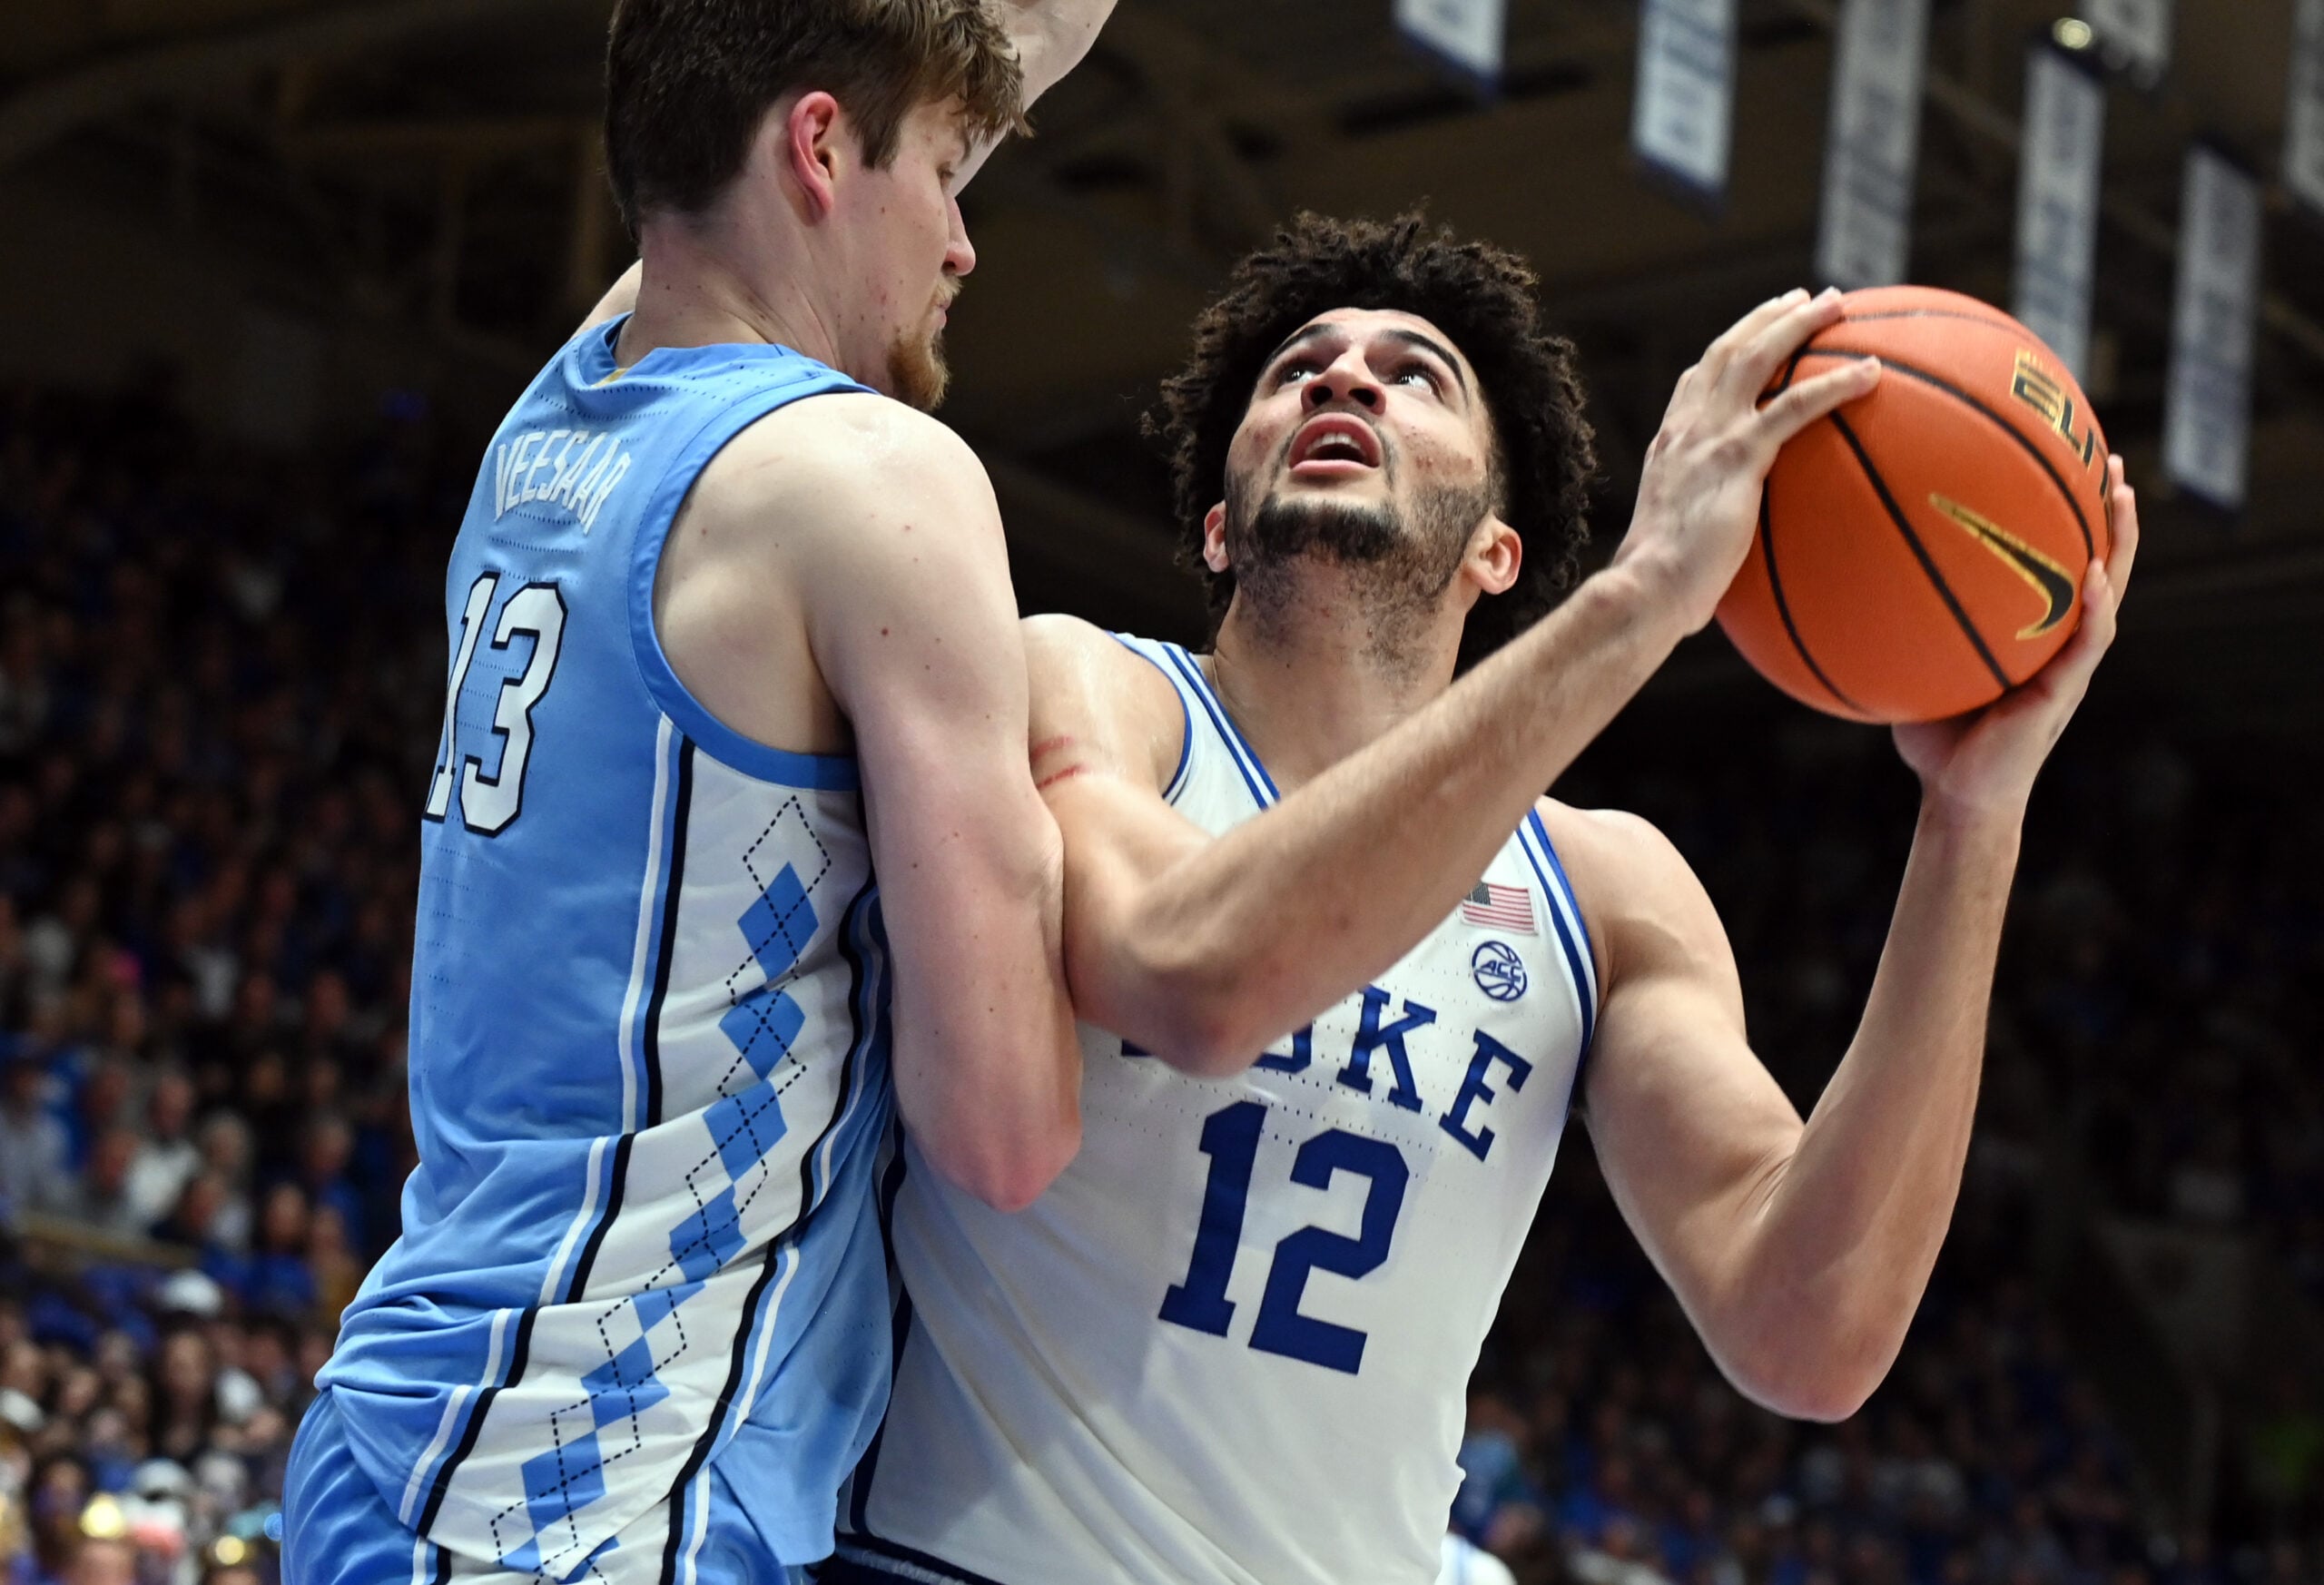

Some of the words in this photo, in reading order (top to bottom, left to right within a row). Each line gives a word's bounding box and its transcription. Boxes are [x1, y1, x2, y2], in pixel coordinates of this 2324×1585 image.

[494, 429, 632, 537] VEESAAR
[422, 571, 567, 837] 13
[1477, 960, 1522, 984] ACC
[1121, 984, 1532, 1162] KE
[1157, 1100, 1410, 1375] 12
